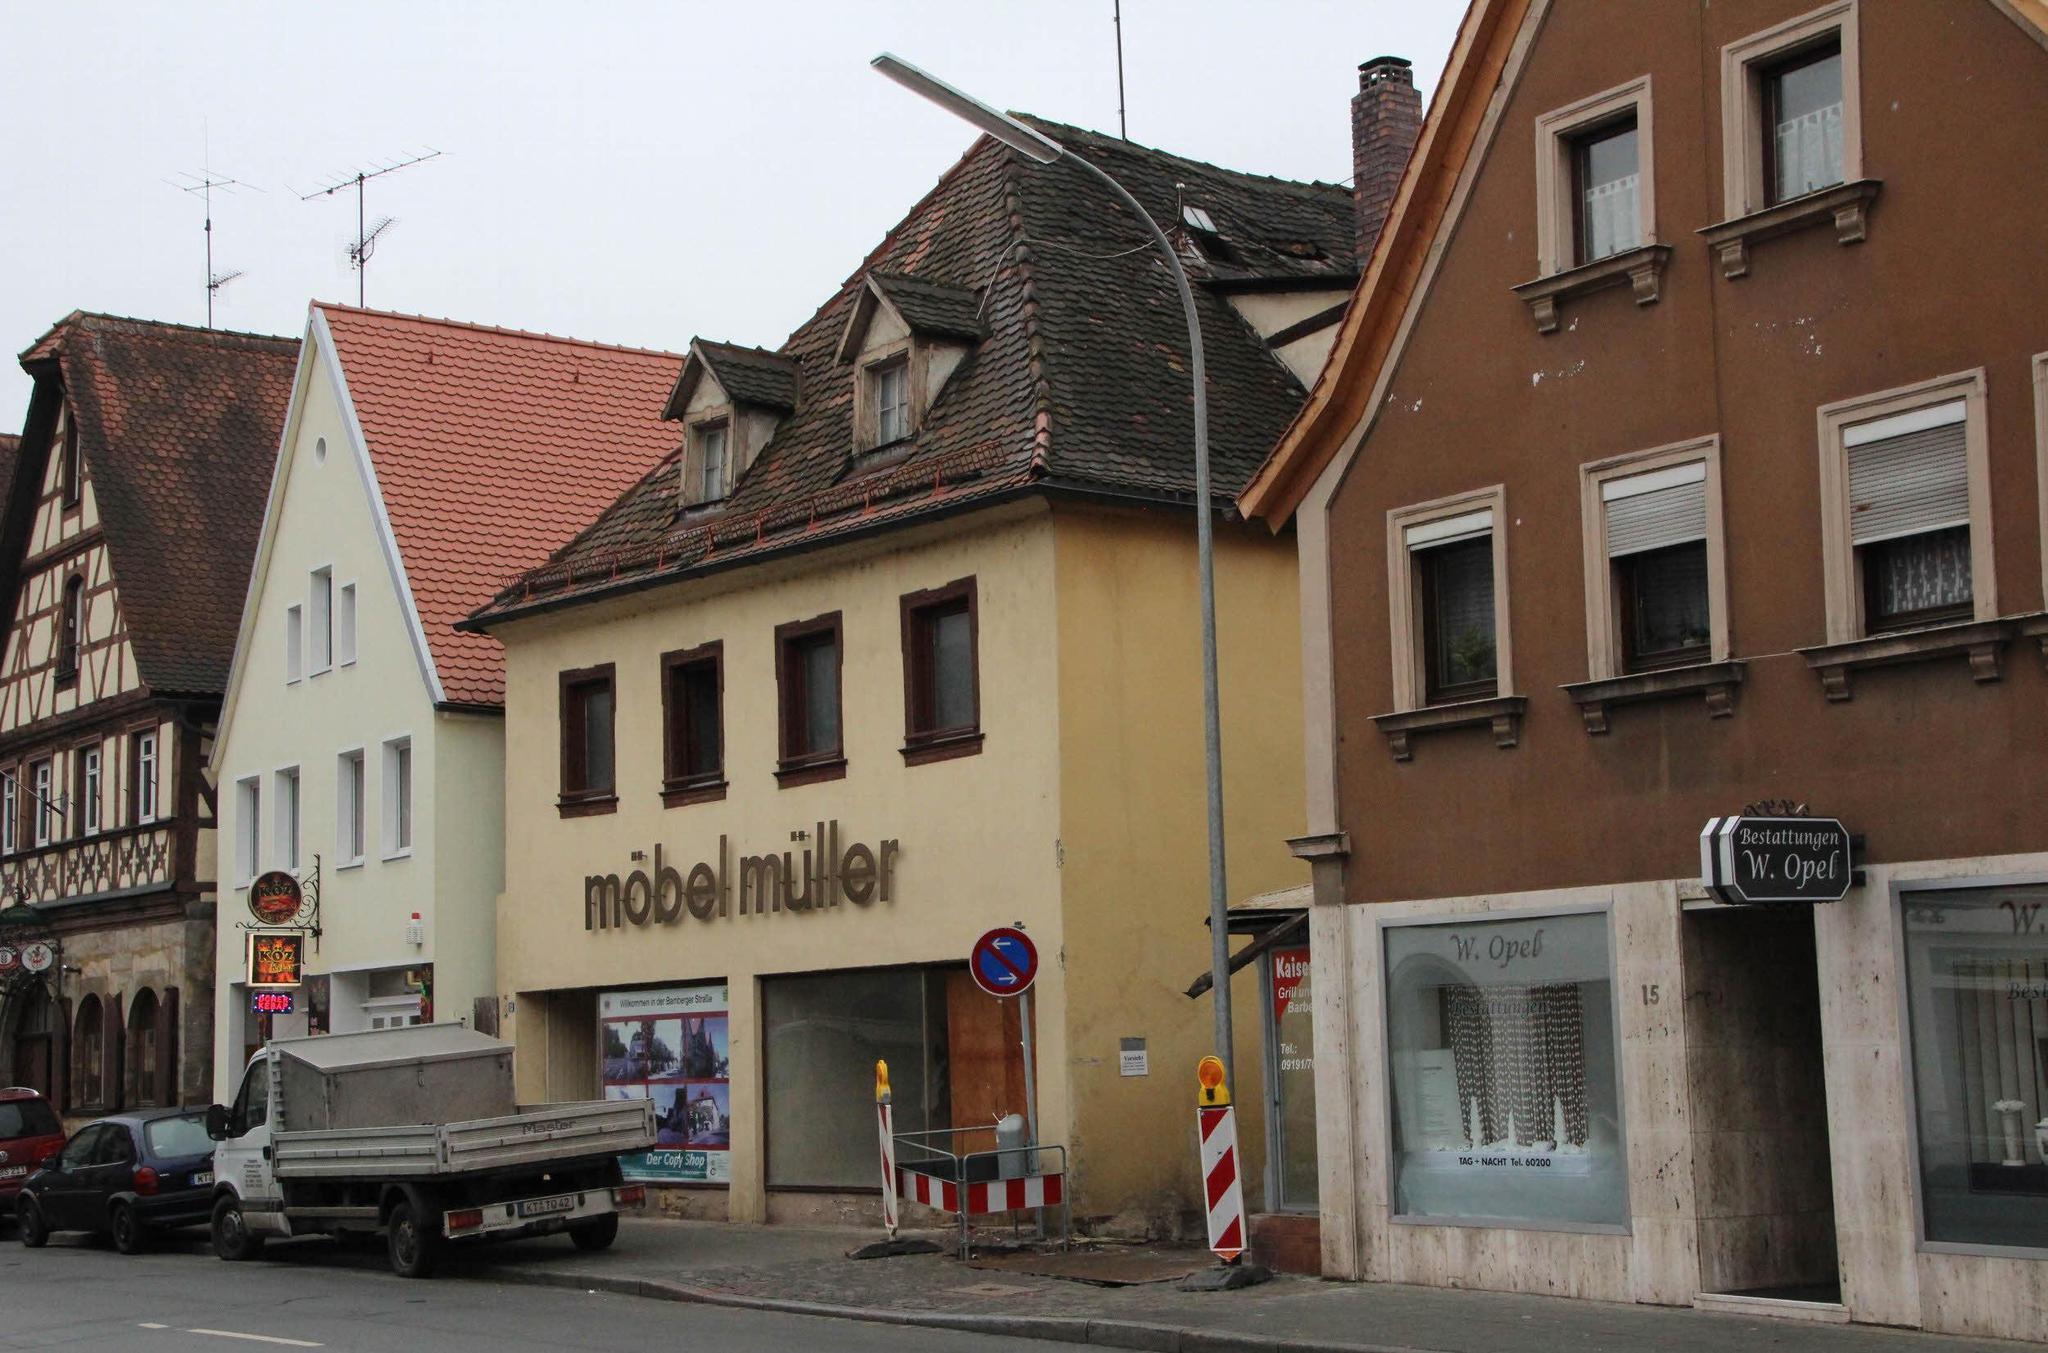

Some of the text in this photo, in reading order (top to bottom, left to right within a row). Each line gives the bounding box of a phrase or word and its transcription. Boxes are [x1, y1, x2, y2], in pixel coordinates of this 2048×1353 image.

[1740, 828, 1839, 851] Bestattungen
[585, 819, 899, 930] möbel müller
[1742, 850, 1840, 889] W. Opel
[1998, 901, 2045, 935] W.
[258, 946, 295, 963] KÖZ
[1450, 929, 1544, 968] W. Opel
[1278, 986, 1312, 999] Grill un
[1642, 984, 1659, 1005] 15
[620, 999, 650, 1008] Willkommen
[657, 997, 665, 1006] der
[523, 1120, 576, 1135] Master
[646, 1153, 661, 1165] Der
[664, 1153, 684, 1168] Copy
[685, 1153, 705, 1168] Shop
[1459, 1157, 1473, 1166] TAG
[1482, 1158, 1507, 1166] NACHT
[1510, 1158, 1523, 1166] Tel.
[1525, 1158, 1551, 1167] 60200
